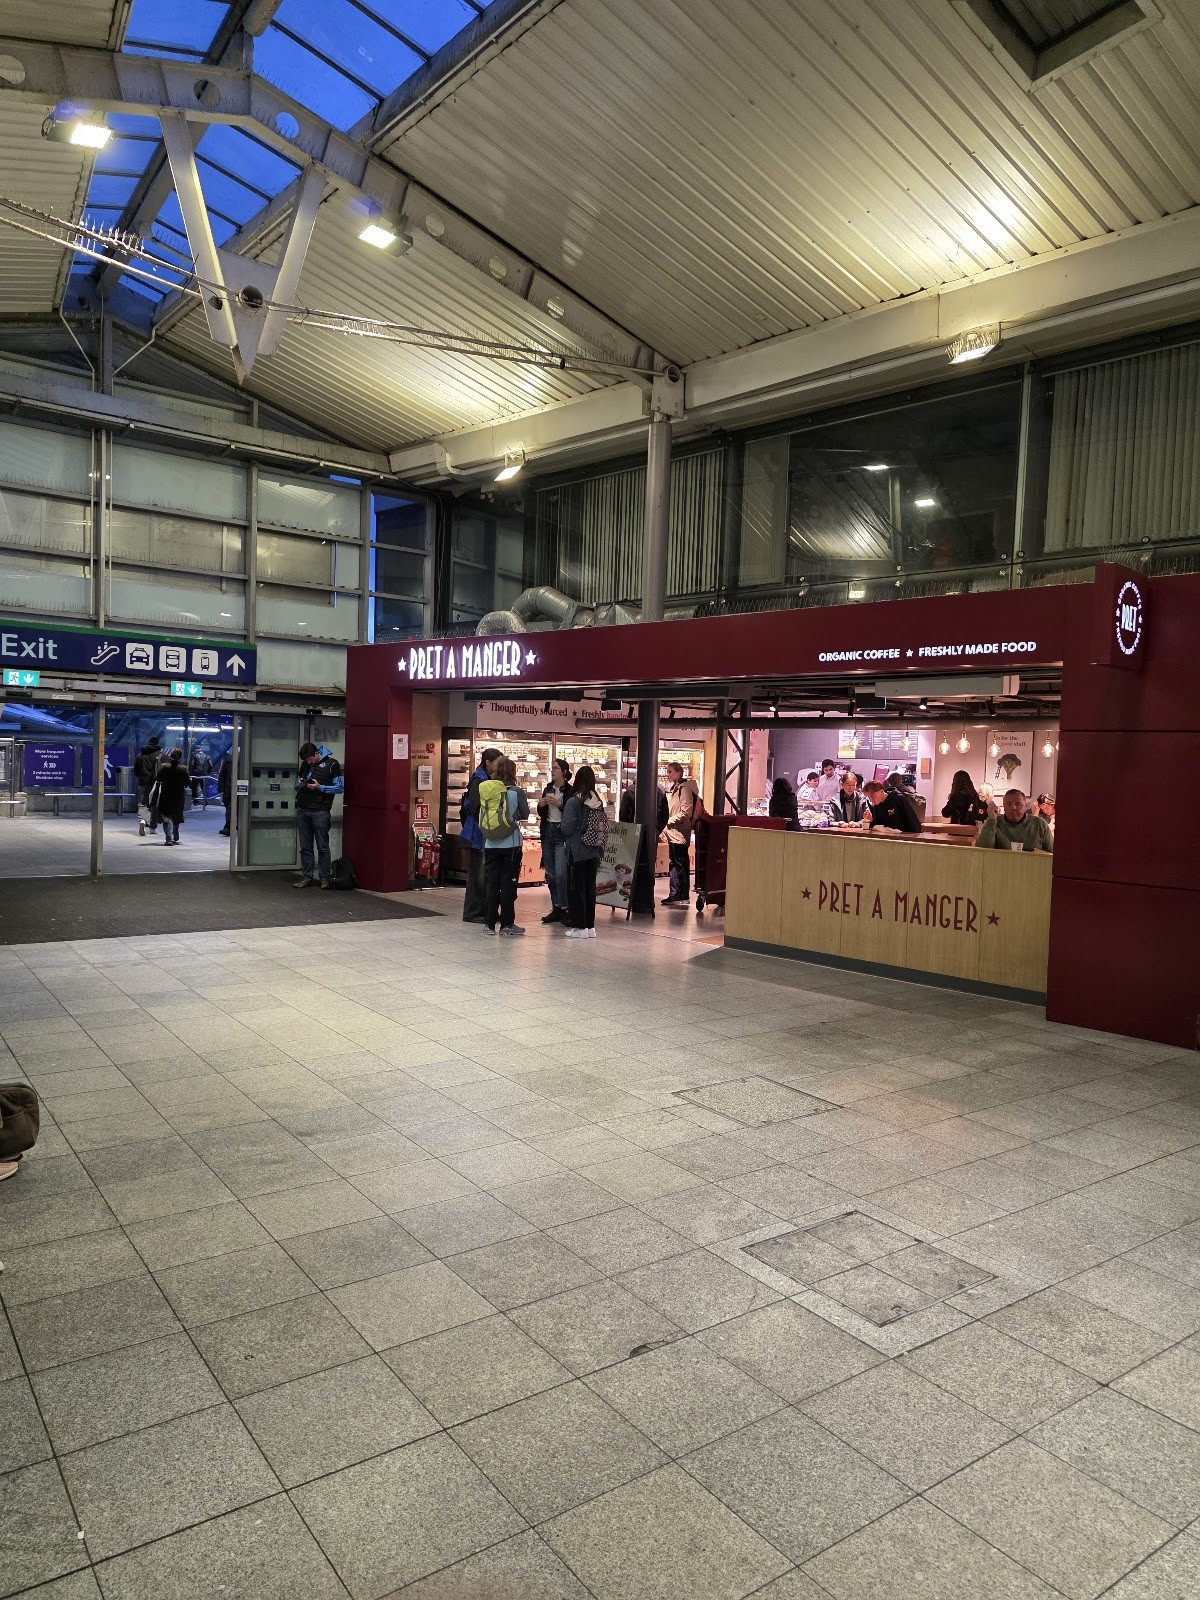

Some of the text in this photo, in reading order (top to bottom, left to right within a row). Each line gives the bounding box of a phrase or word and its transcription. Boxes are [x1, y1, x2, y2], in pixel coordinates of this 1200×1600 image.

[1121, 604, 1138, 632] PRET
[1, 633, 58, 660] Exit
[409, 640, 521, 680] PRET A MANGER
[818, 648, 901, 662] ORGANIC COFFEE
[918, 641, 1037, 657] FRESHLY MADE FOOD
[490, 702, 539, 715] Thoughtfully
[818, 879, 978, 933] PRET A MANGER
